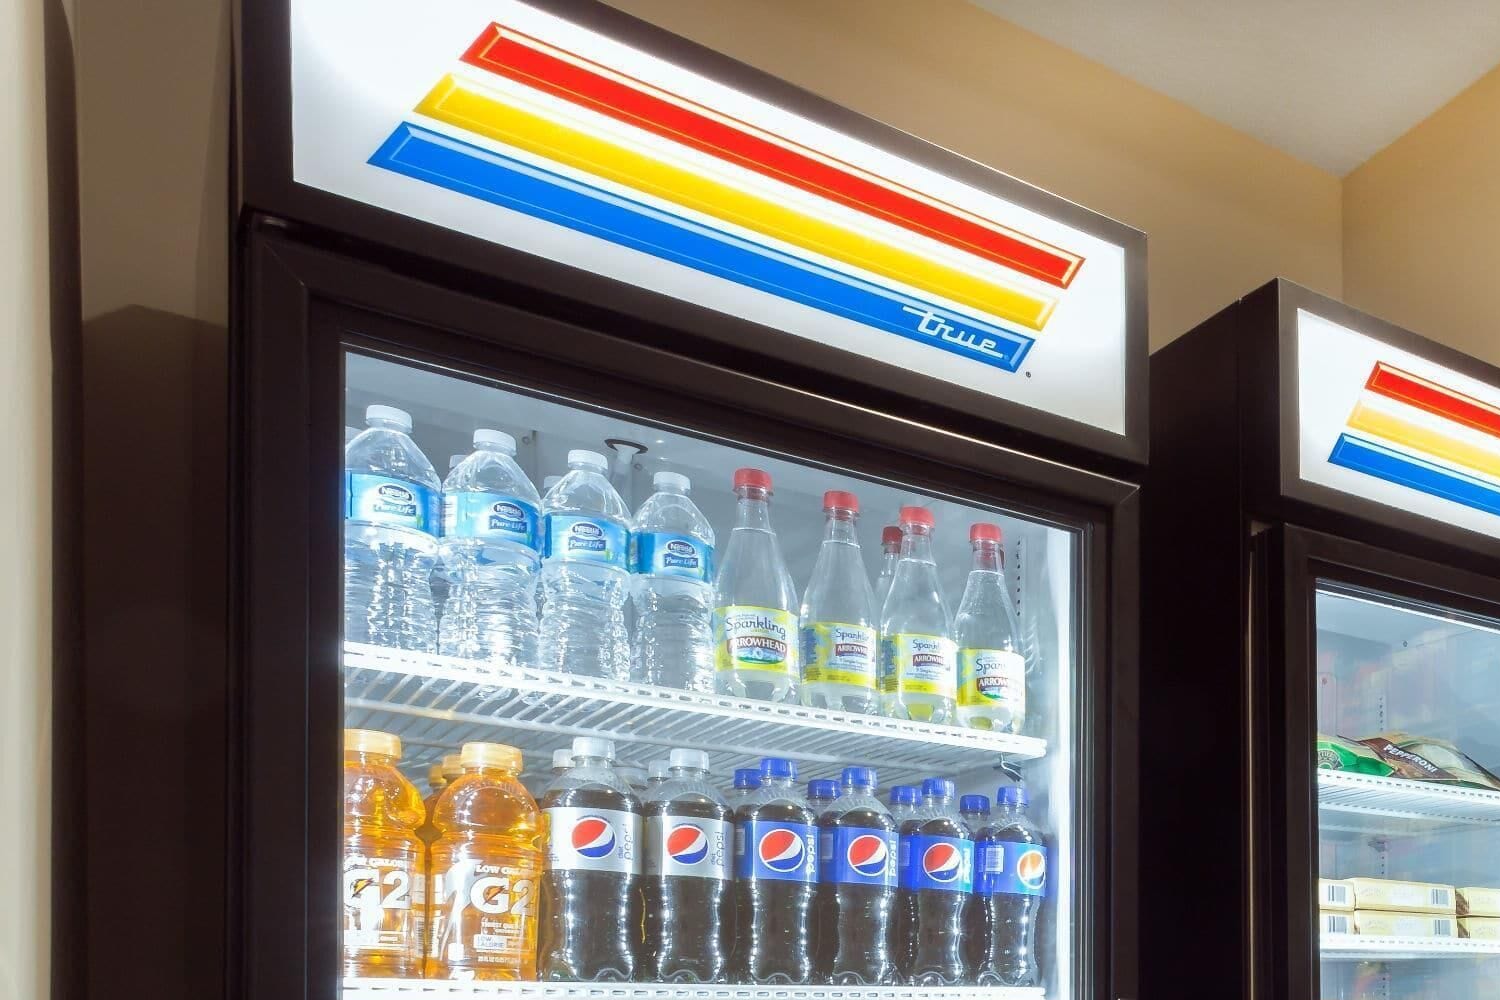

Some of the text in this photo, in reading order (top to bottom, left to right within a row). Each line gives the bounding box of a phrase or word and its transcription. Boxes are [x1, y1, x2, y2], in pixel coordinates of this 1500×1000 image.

[491, 519, 525, 530] Pure Life
[684, 558, 697, 566] Life
[726, 615, 786, 640] Sparkling
[729, 636, 786, 653] ARROWHEAD
[1384, 744, 1438, 773] PEPPERONI
[715, 832, 724, 866] pepsi
[806, 834, 815, 879] pepsi
[888, 839, 897, 877] pepsi
[470, 877, 535, 915] G2
